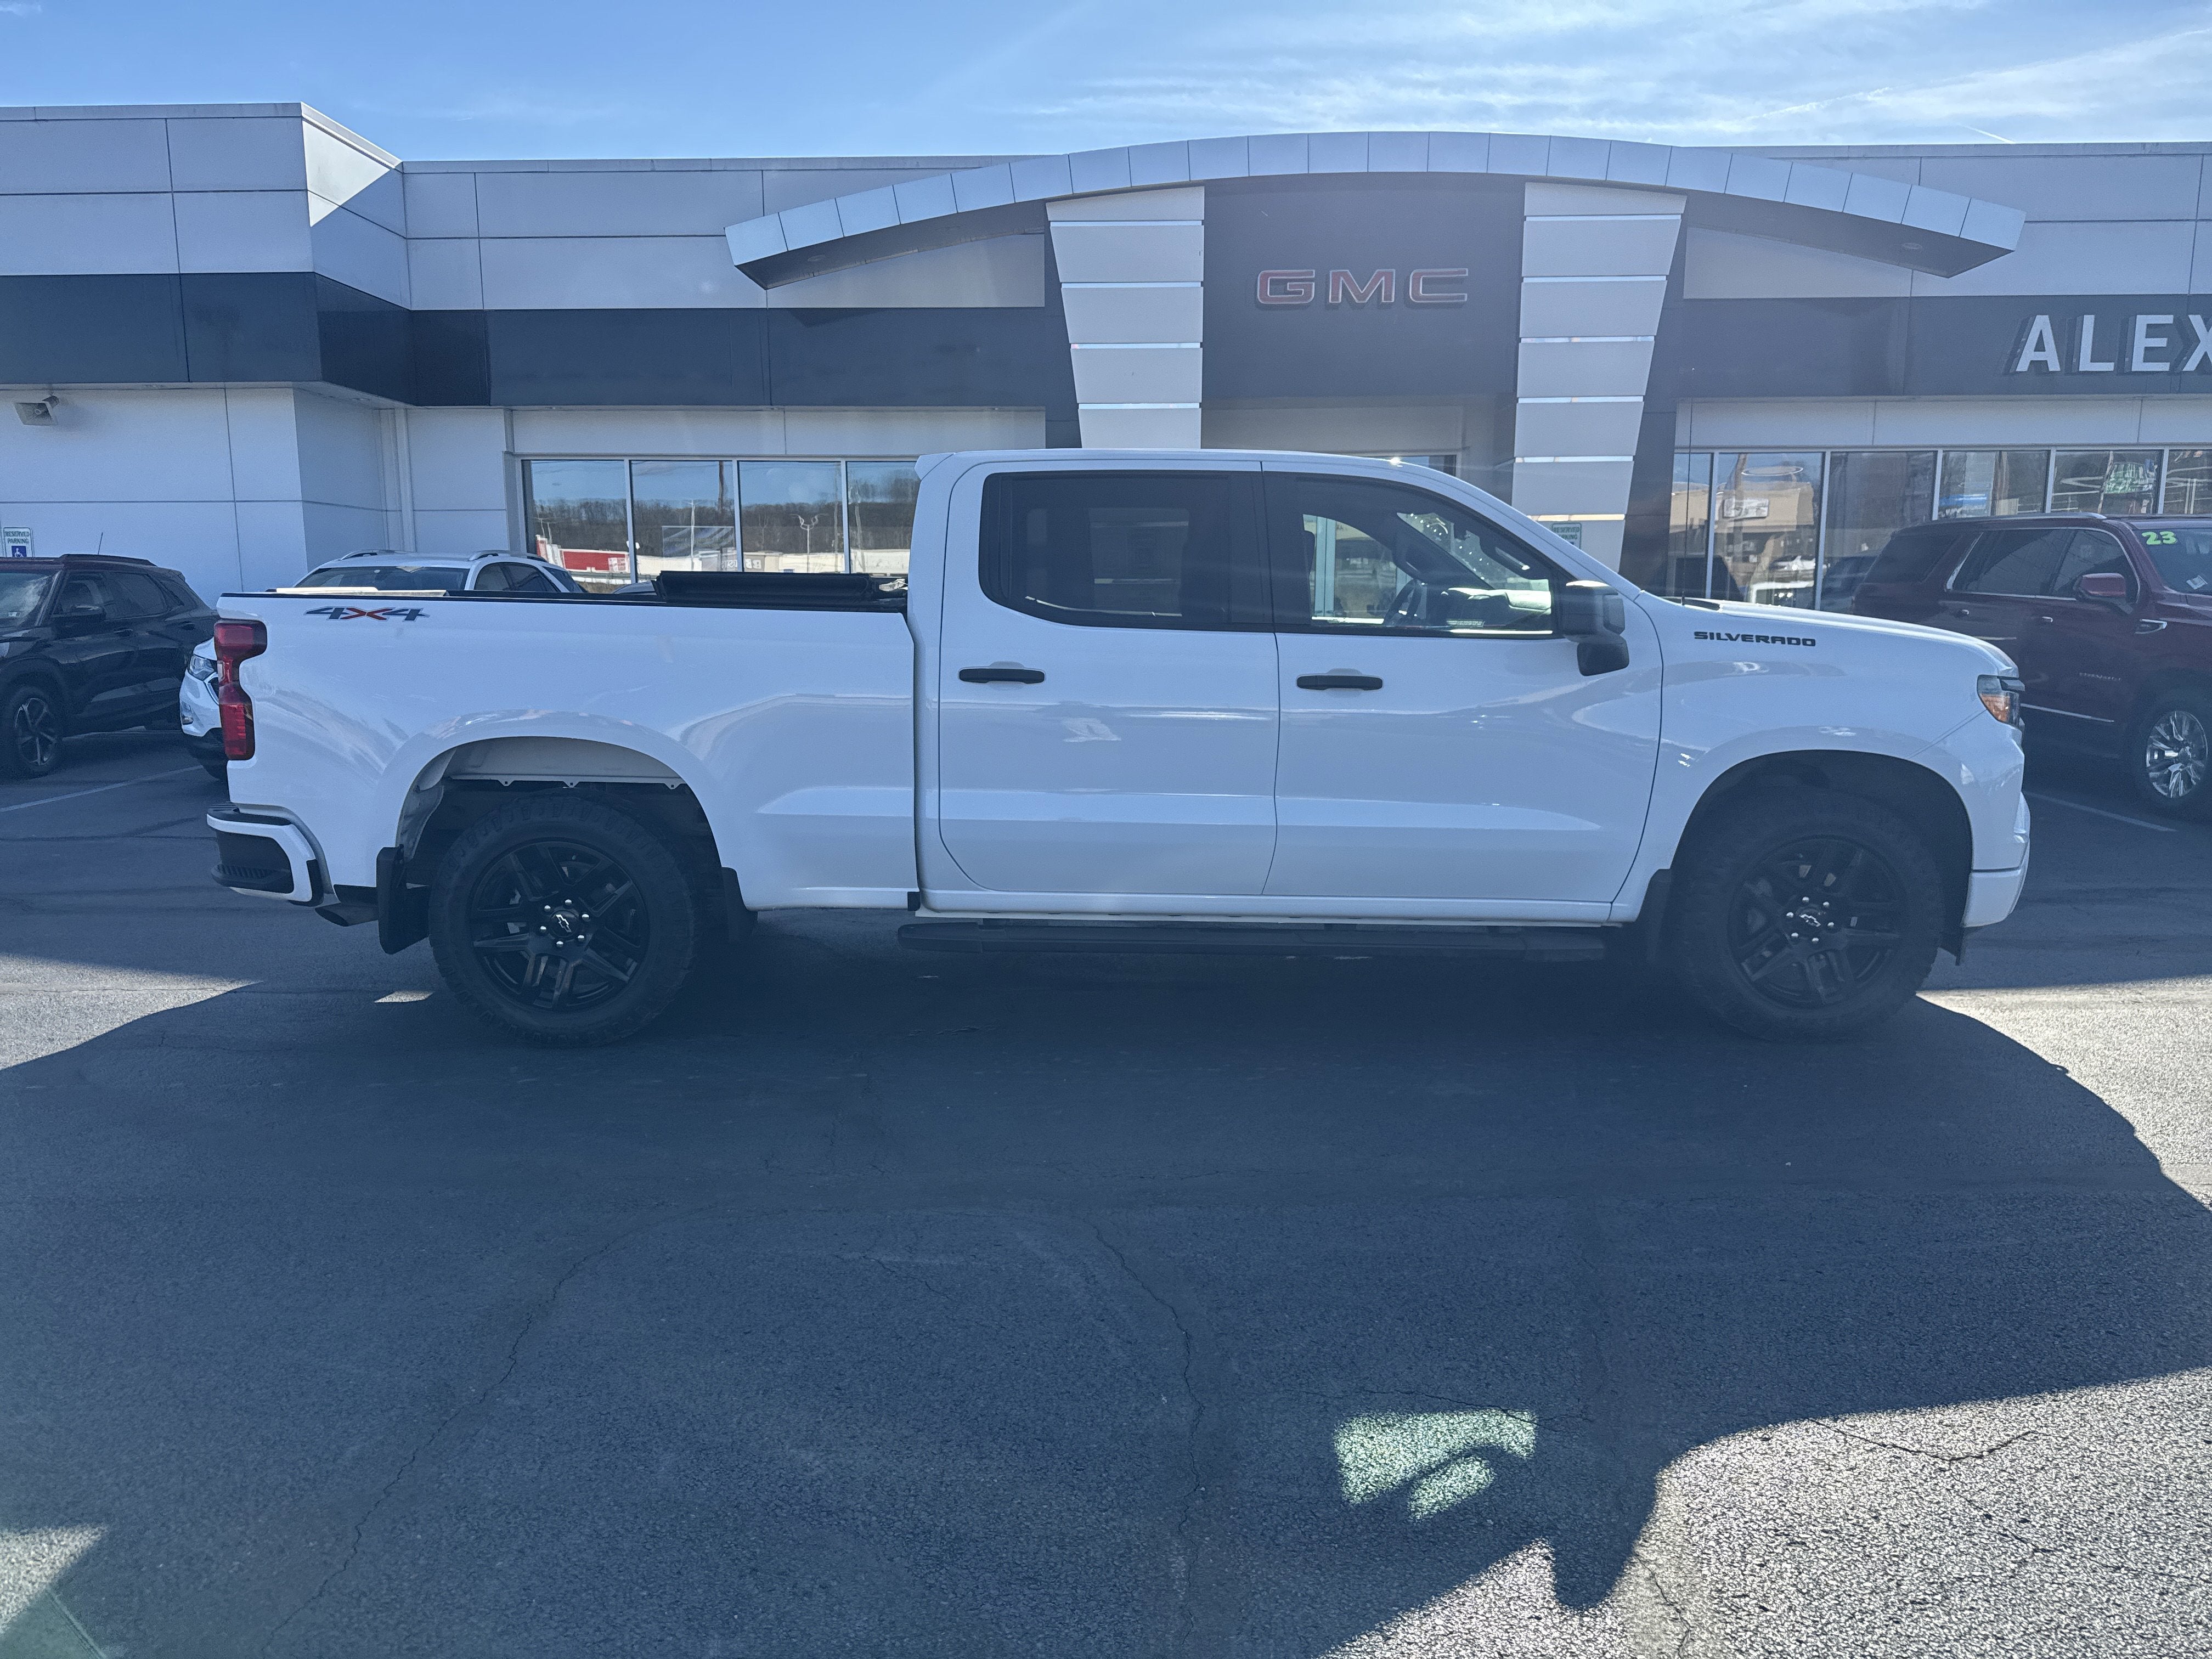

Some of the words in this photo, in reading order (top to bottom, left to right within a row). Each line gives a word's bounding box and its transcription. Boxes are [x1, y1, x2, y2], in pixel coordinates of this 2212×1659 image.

[1257, 268, 1469, 304] GMC
[2015, 314, 2212, 372] ALEX
[2141, 531, 2177, 545] 23
[1694, 631, 1816, 647] SILVERADO
